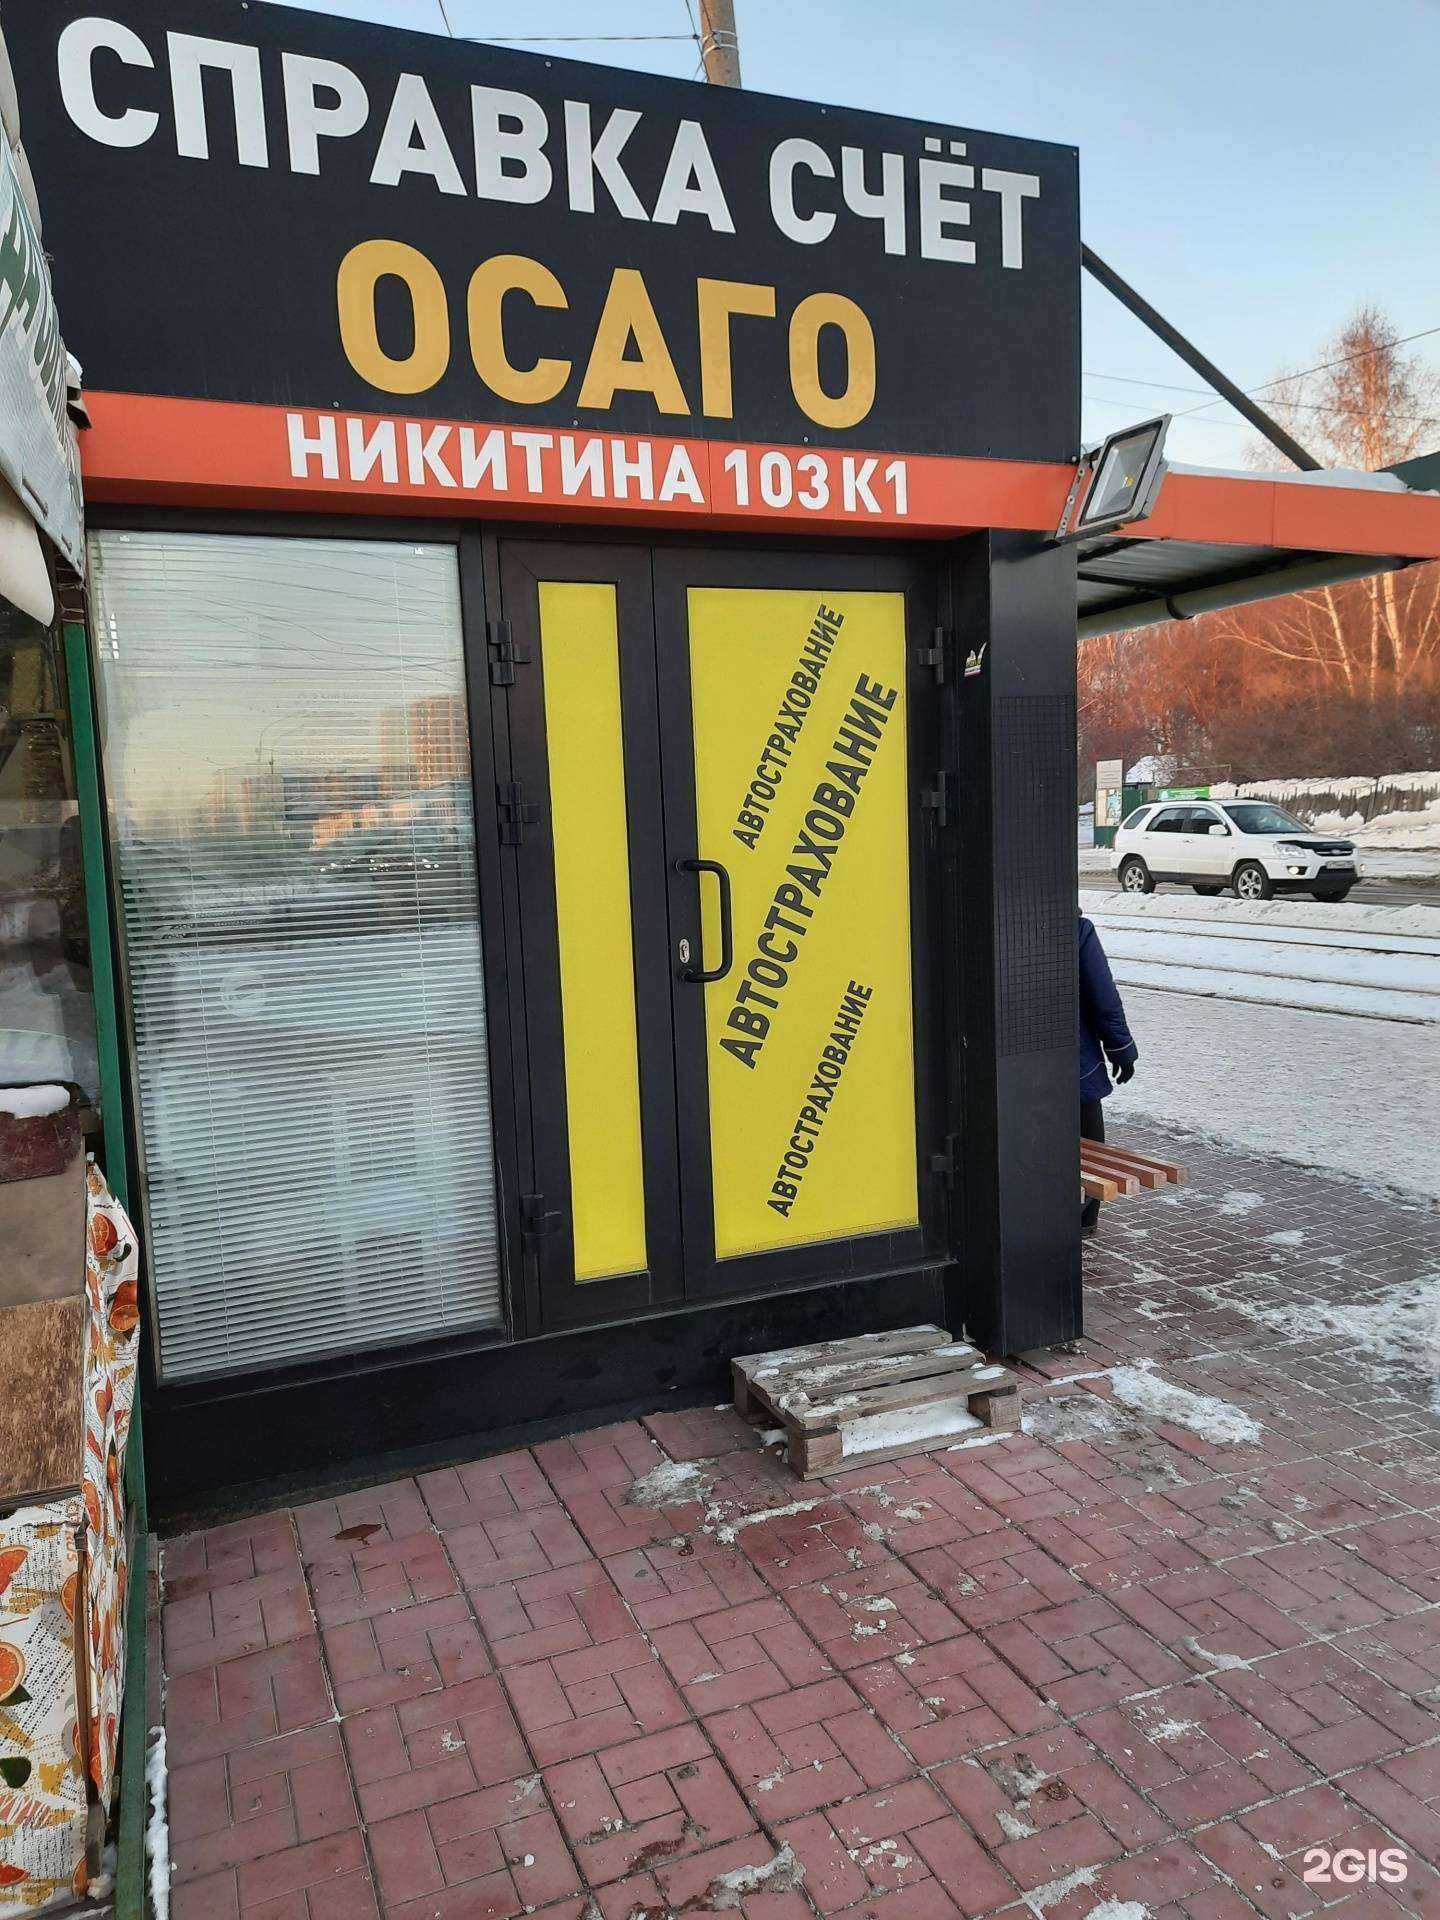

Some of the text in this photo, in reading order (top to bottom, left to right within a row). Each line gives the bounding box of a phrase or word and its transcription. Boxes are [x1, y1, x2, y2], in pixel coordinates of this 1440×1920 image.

[58, 17, 1040, 270] СПРАВКА СЧЁТ
[337, 240, 876, 429] ОСАГО
[287, 414, 705, 504] НИКИТИНА
[732, 604, 845, 850] АВТОСТРАХОВАНИЕ
[719, 673, 898, 1069] АВТОСТРАХОВАНИЕ
[766, 980, 874, 1218] АВТОСТРАХОВАНИЕ
